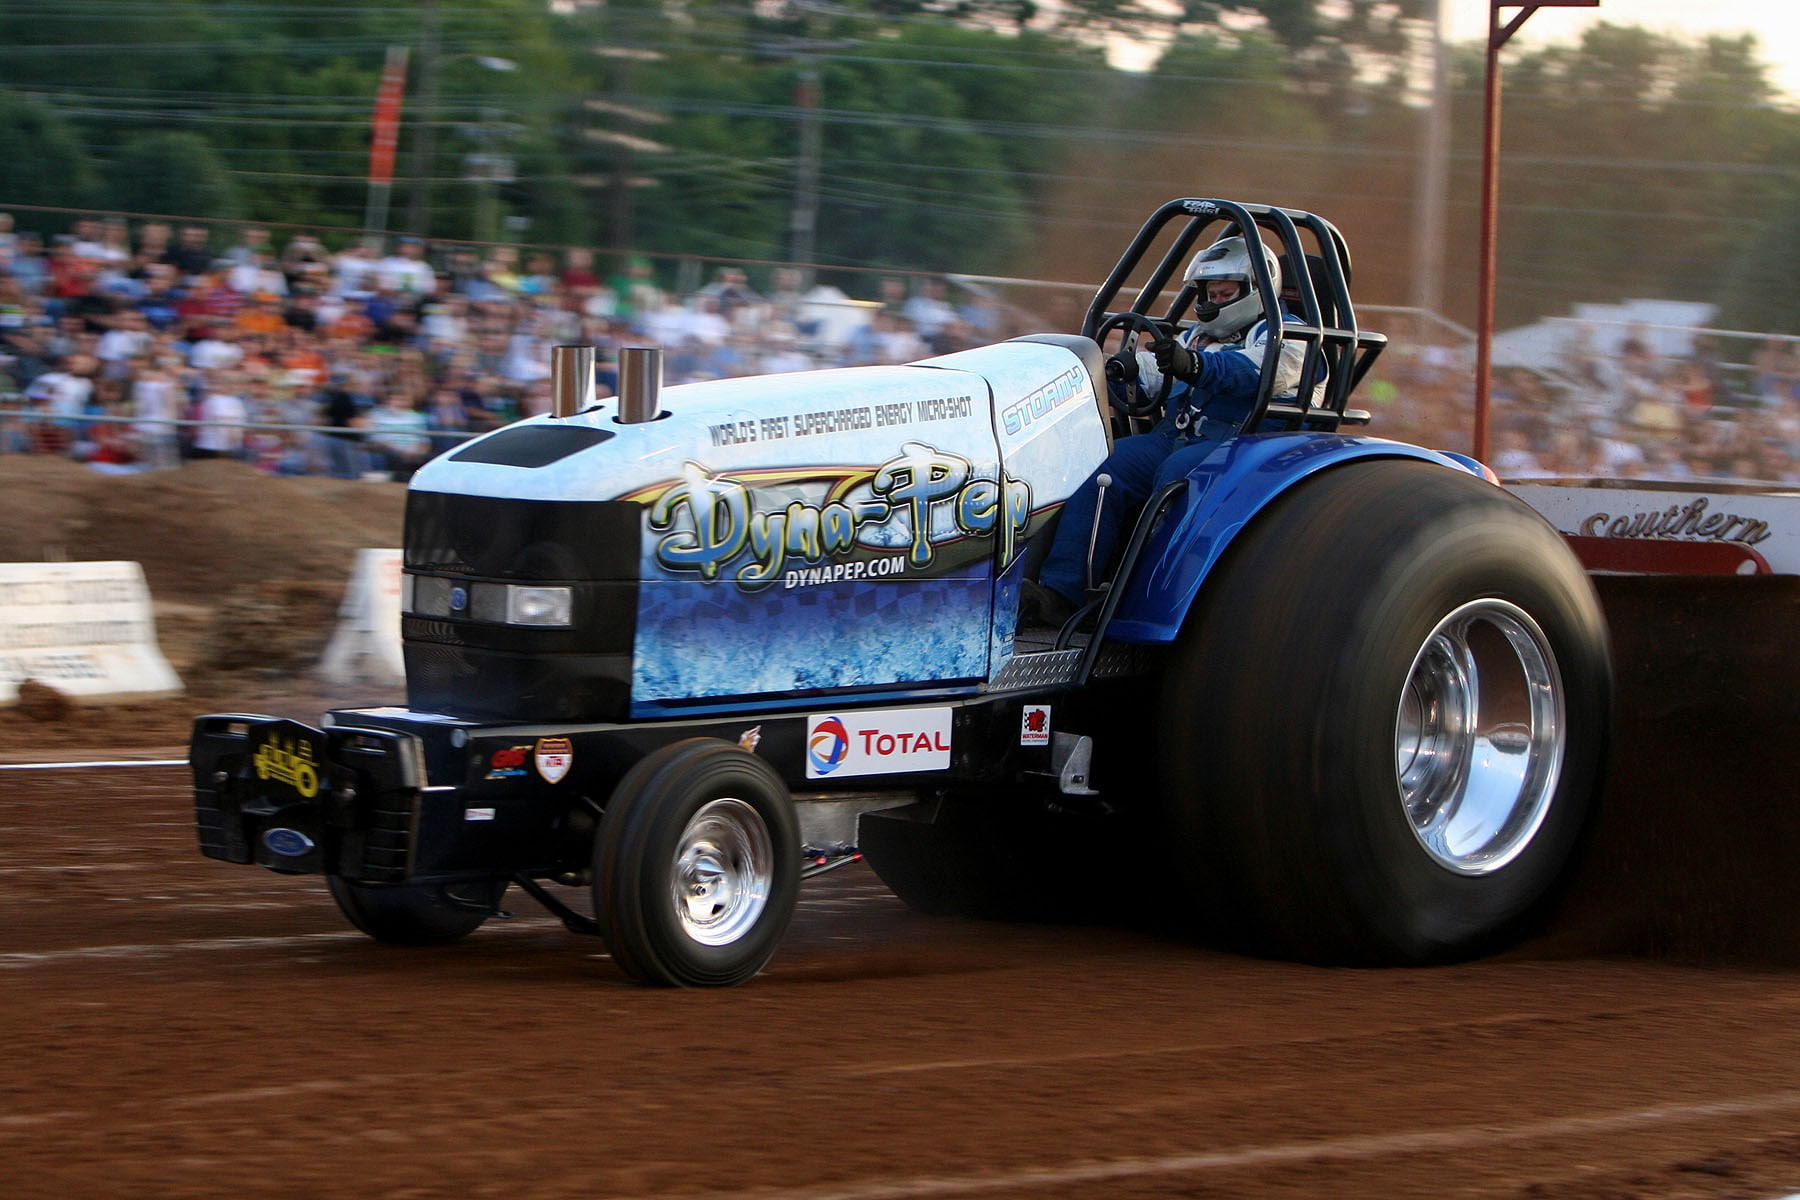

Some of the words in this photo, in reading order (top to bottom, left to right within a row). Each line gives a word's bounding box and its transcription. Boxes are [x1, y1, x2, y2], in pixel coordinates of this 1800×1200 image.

[708, 420, 756, 447] WORLD'S
[760, 416, 789, 441] FIRST
[795, 406, 872, 437] SUPERCHARGED
[875, 402, 913, 427] ENERGY
[917, 395, 972, 423] MICRO-SHOT
[1001, 365, 1084, 436] STORMY
[1580, 497, 1771, 544] Southern
[784, 555, 905, 589] DYNAPEP.COM
